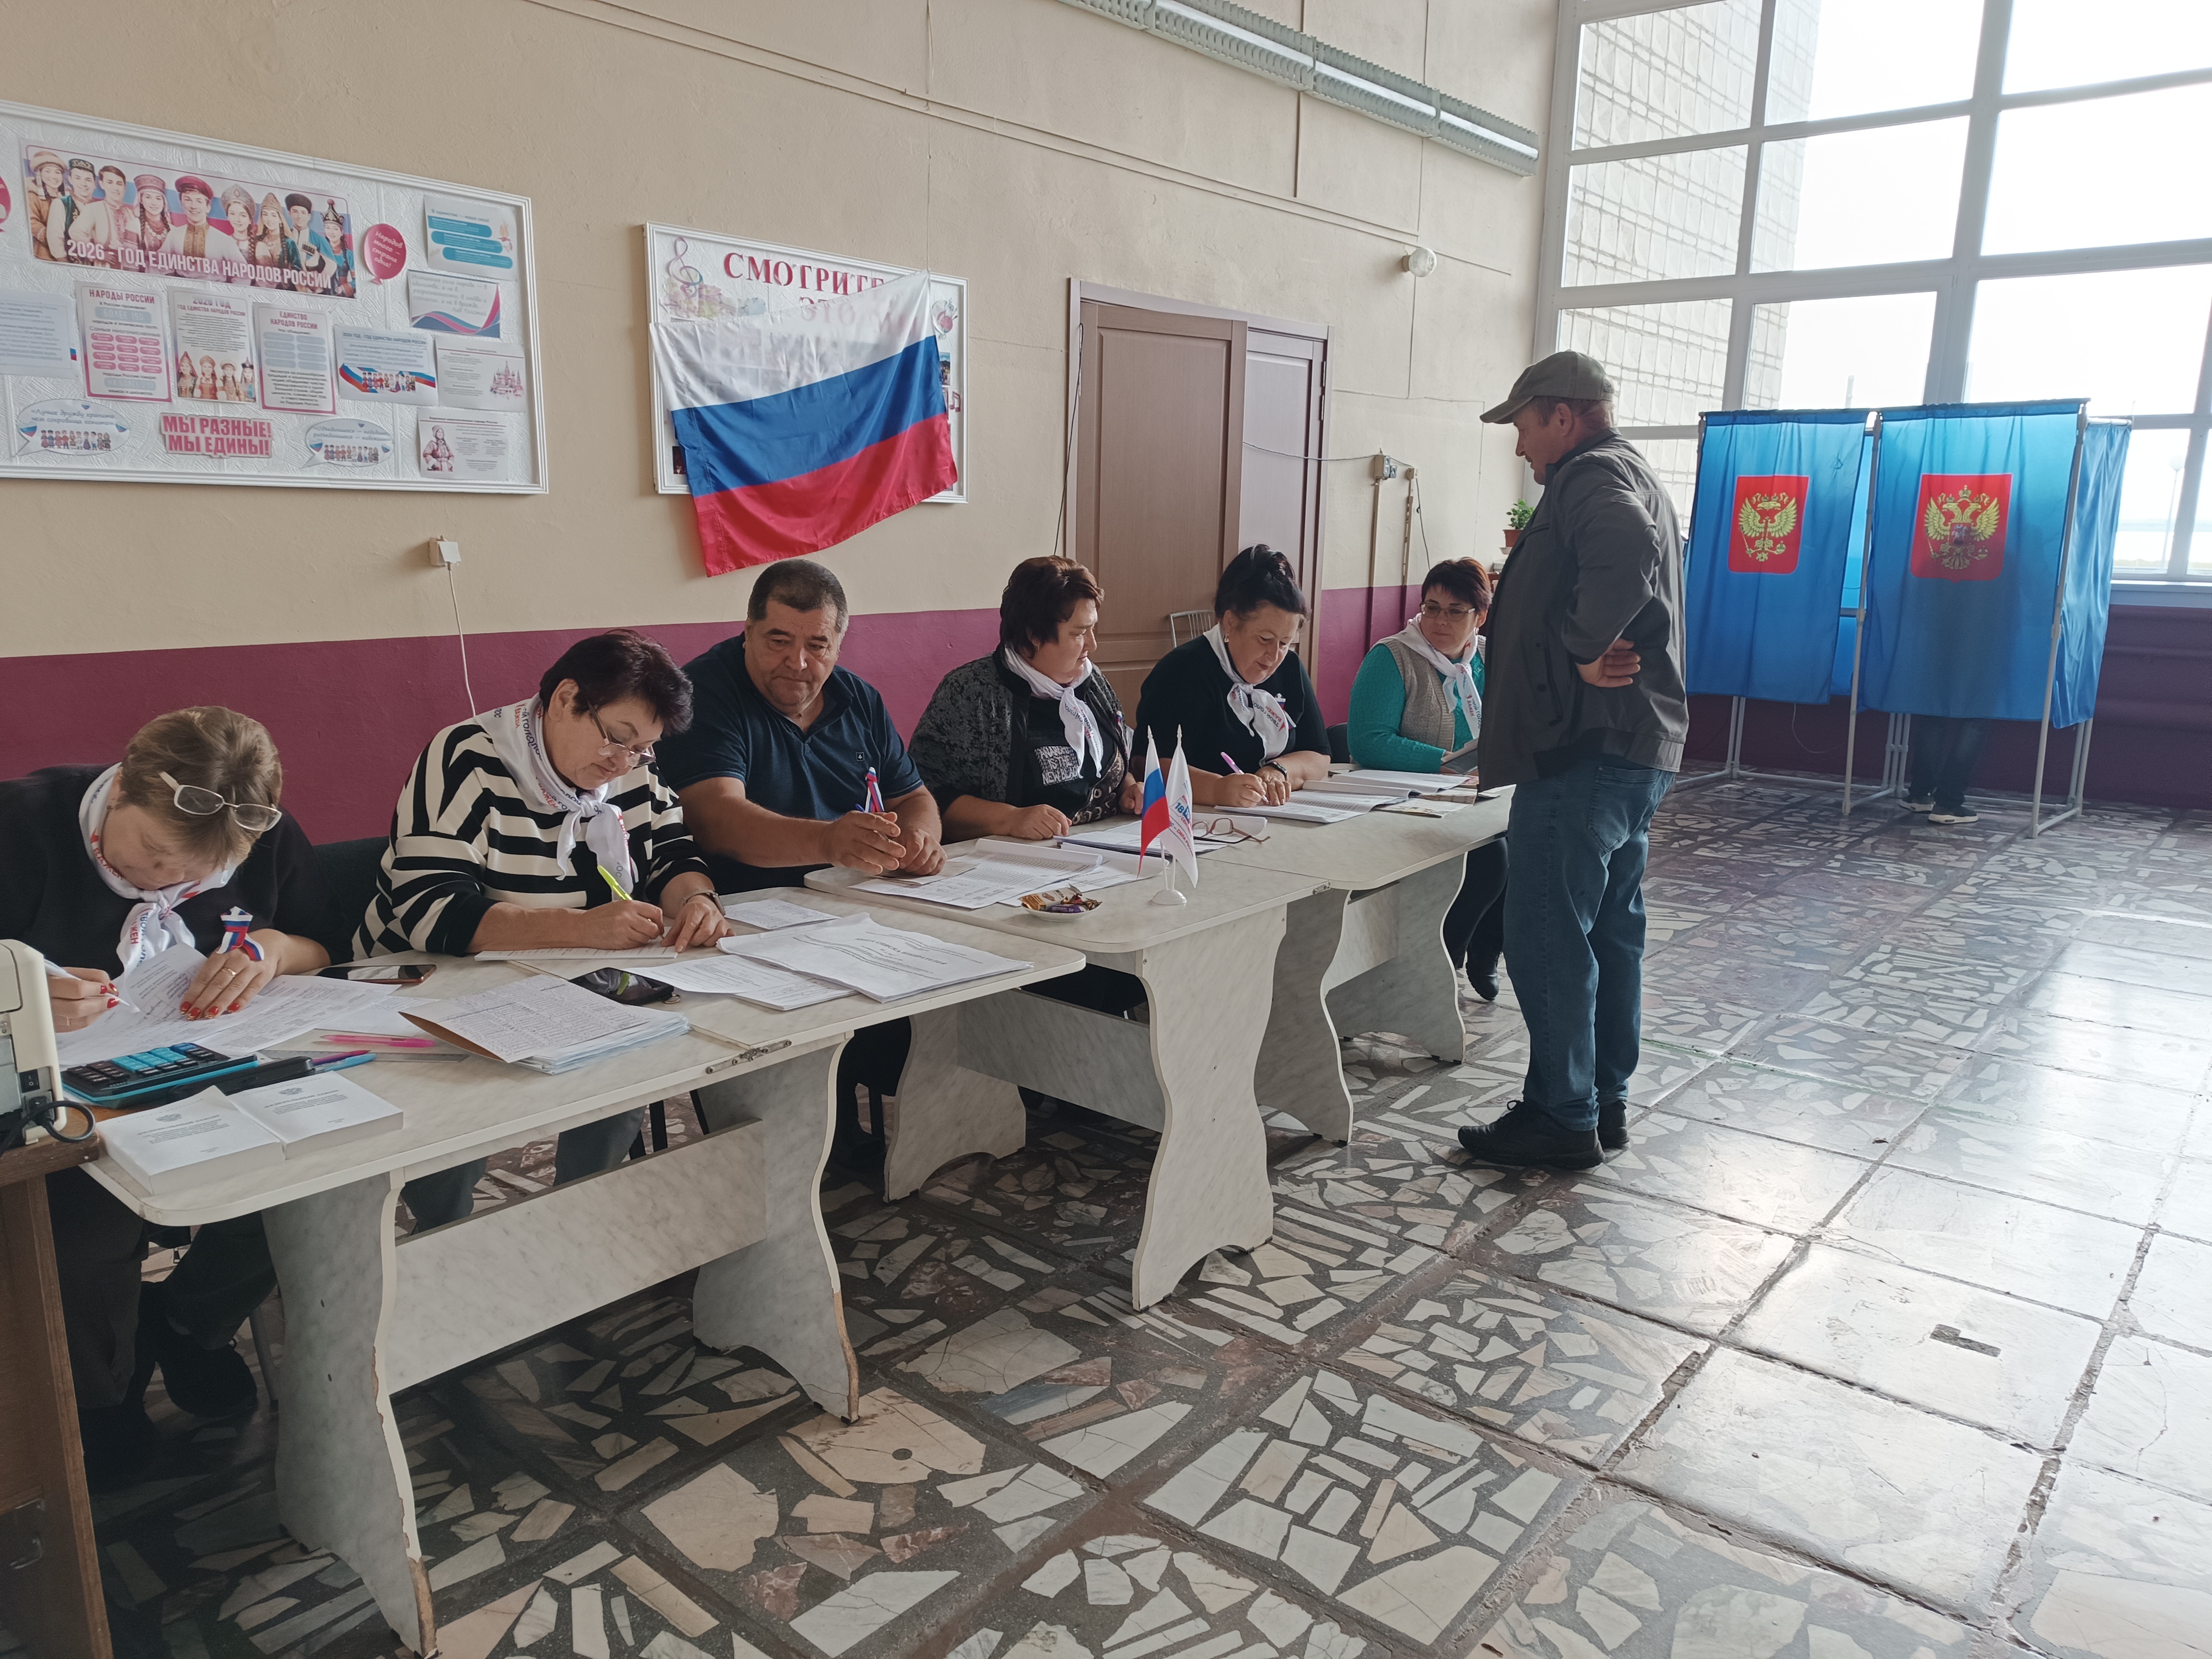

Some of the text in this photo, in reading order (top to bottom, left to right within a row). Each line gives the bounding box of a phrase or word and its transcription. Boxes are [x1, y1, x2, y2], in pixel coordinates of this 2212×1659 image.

[373, 239, 393, 252] много
[375, 231, 403, 248] Народов
[372, 248, 397, 263] страна
[374, 255, 392, 268] одна!
[67, 239, 105, 260] 2026
[118, 247, 146, 268] ГОД
[149, 251, 220, 275] ЕДИНСТВА
[222, 260, 281, 284] НАРОДОВ
[283, 269, 332, 289] РОССИИ
[89, 289, 155, 304] НАРОДЫ РОССИИ
[192, 295, 231, 310] 2026 ГОД
[103, 309, 144, 321] БОЛЕЕ 190
[279, 311, 307, 320] ЕДИНСТВО
[270, 319, 295, 327] НАРОДОВ
[163, 415, 272, 438] МЫ РАЗНЫЕ!
[168, 435, 270, 457] МЫ ЕДИНЫ!
[1057, 755, 1073, 768] THE
[1042, 771, 1062, 785] NEW
[1175, 802, 1185, 814] 18
[1176, 829, 1186, 841] СИЛА
